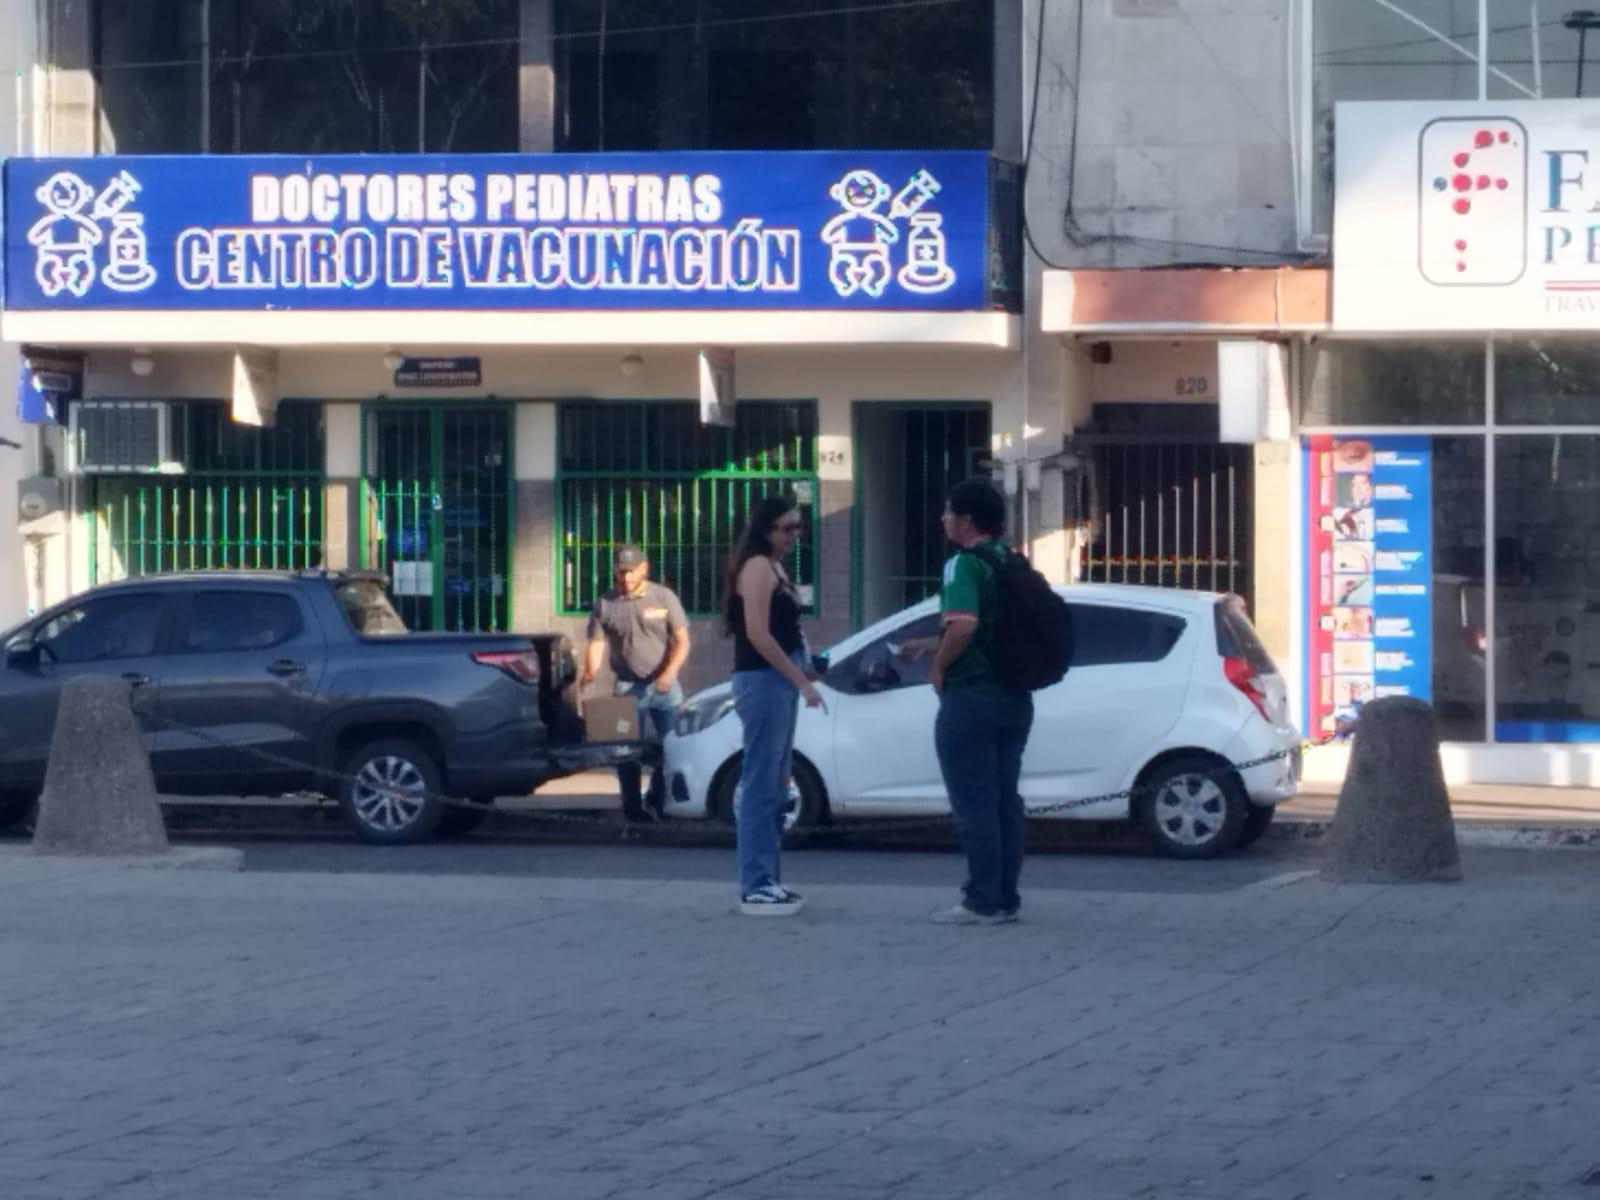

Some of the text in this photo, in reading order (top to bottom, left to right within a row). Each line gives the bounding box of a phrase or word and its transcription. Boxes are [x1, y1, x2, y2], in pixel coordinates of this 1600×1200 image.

[250, 173, 722, 223] DOCTORES PEDIATRAS
[1541, 149, 1600, 214] F
[177, 219, 801, 291] CENTRO DE VACUNACIÓN
[1175, 377, 1208, 396] 820
